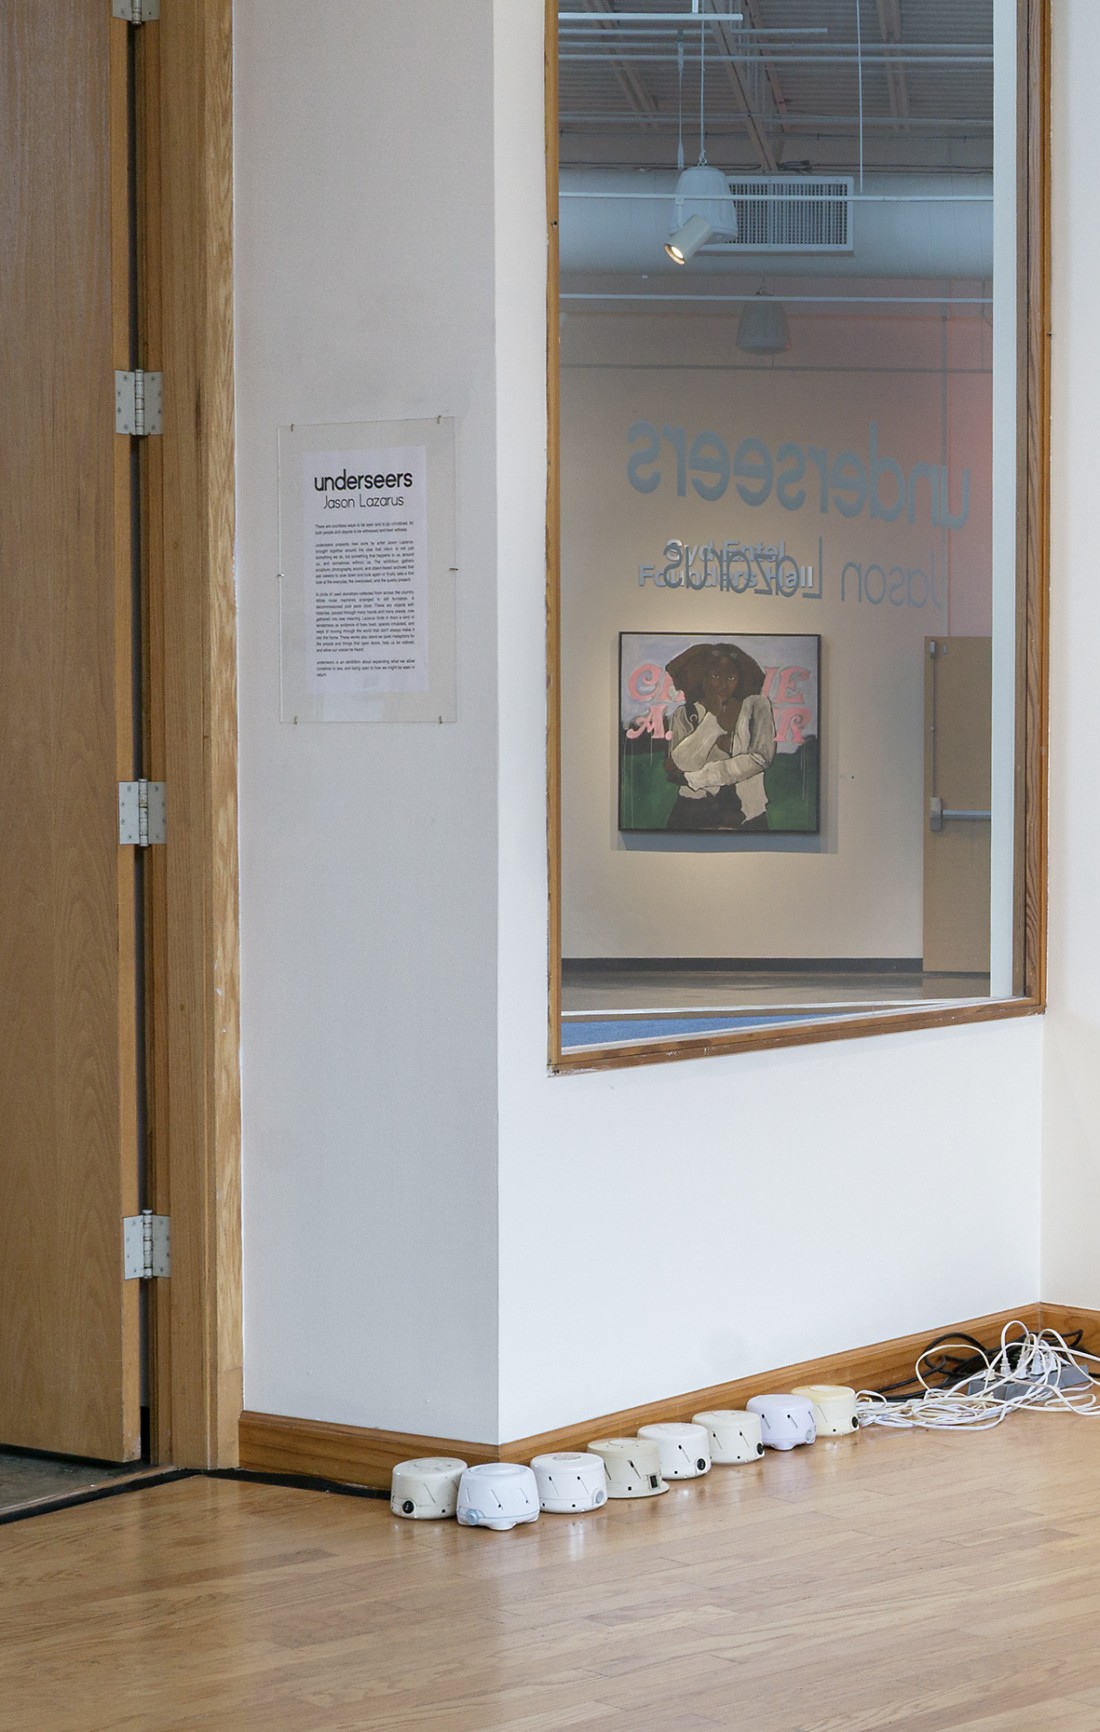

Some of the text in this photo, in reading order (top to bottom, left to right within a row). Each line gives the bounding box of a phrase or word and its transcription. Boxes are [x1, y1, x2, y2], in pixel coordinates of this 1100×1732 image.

[314, 468, 413, 492] underseers
[323, 493, 405, 509] Jason Lazarus
